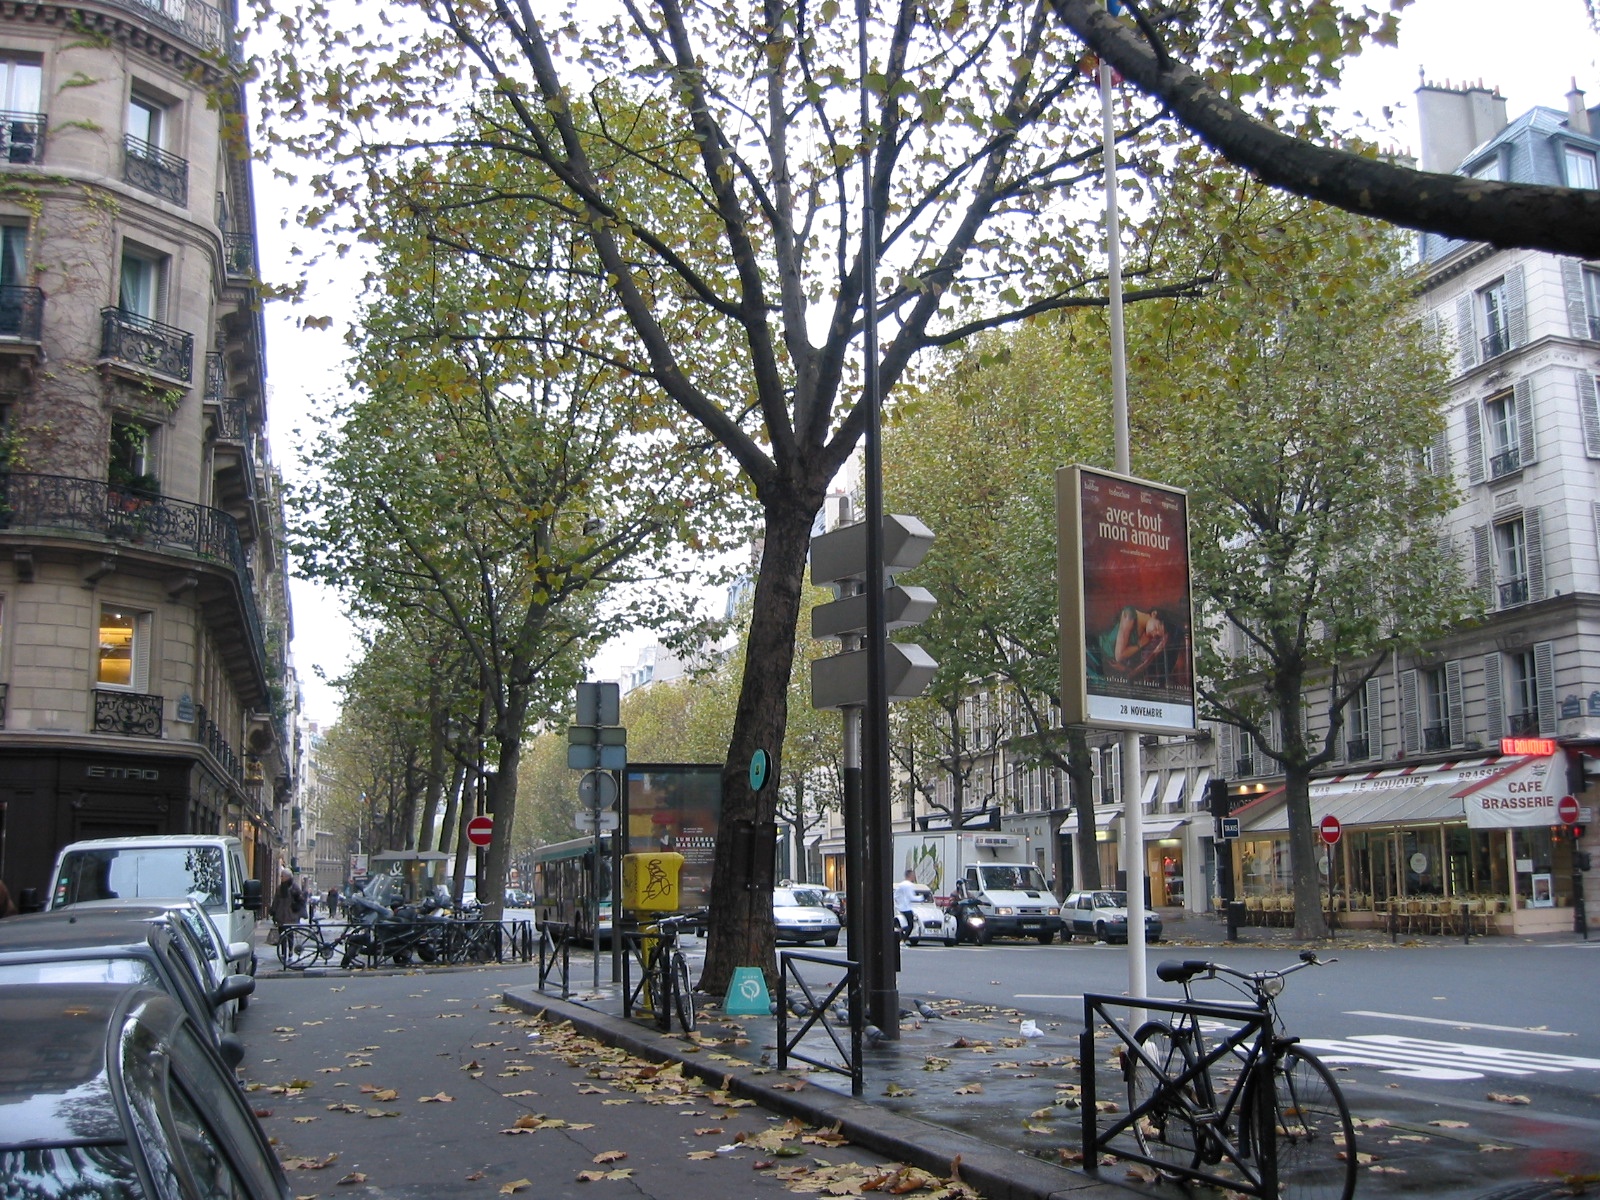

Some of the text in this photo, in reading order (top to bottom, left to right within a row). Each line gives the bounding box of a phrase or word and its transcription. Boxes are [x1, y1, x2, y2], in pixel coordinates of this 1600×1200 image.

[1106, 506, 1162, 533] avec tout
[1098, 522, 1171, 551] mon amour
[1120, 704, 1163, 718] 28 NOVEMBRE
[87, 765, 159, 780] ETRO
[1352, 782, 1367, 793] LE
[1508, 781, 1543, 793] CAFE
[1481, 796, 1554, 810] BRASSERIE
[1224, 824, 1238, 832] TAXIS
